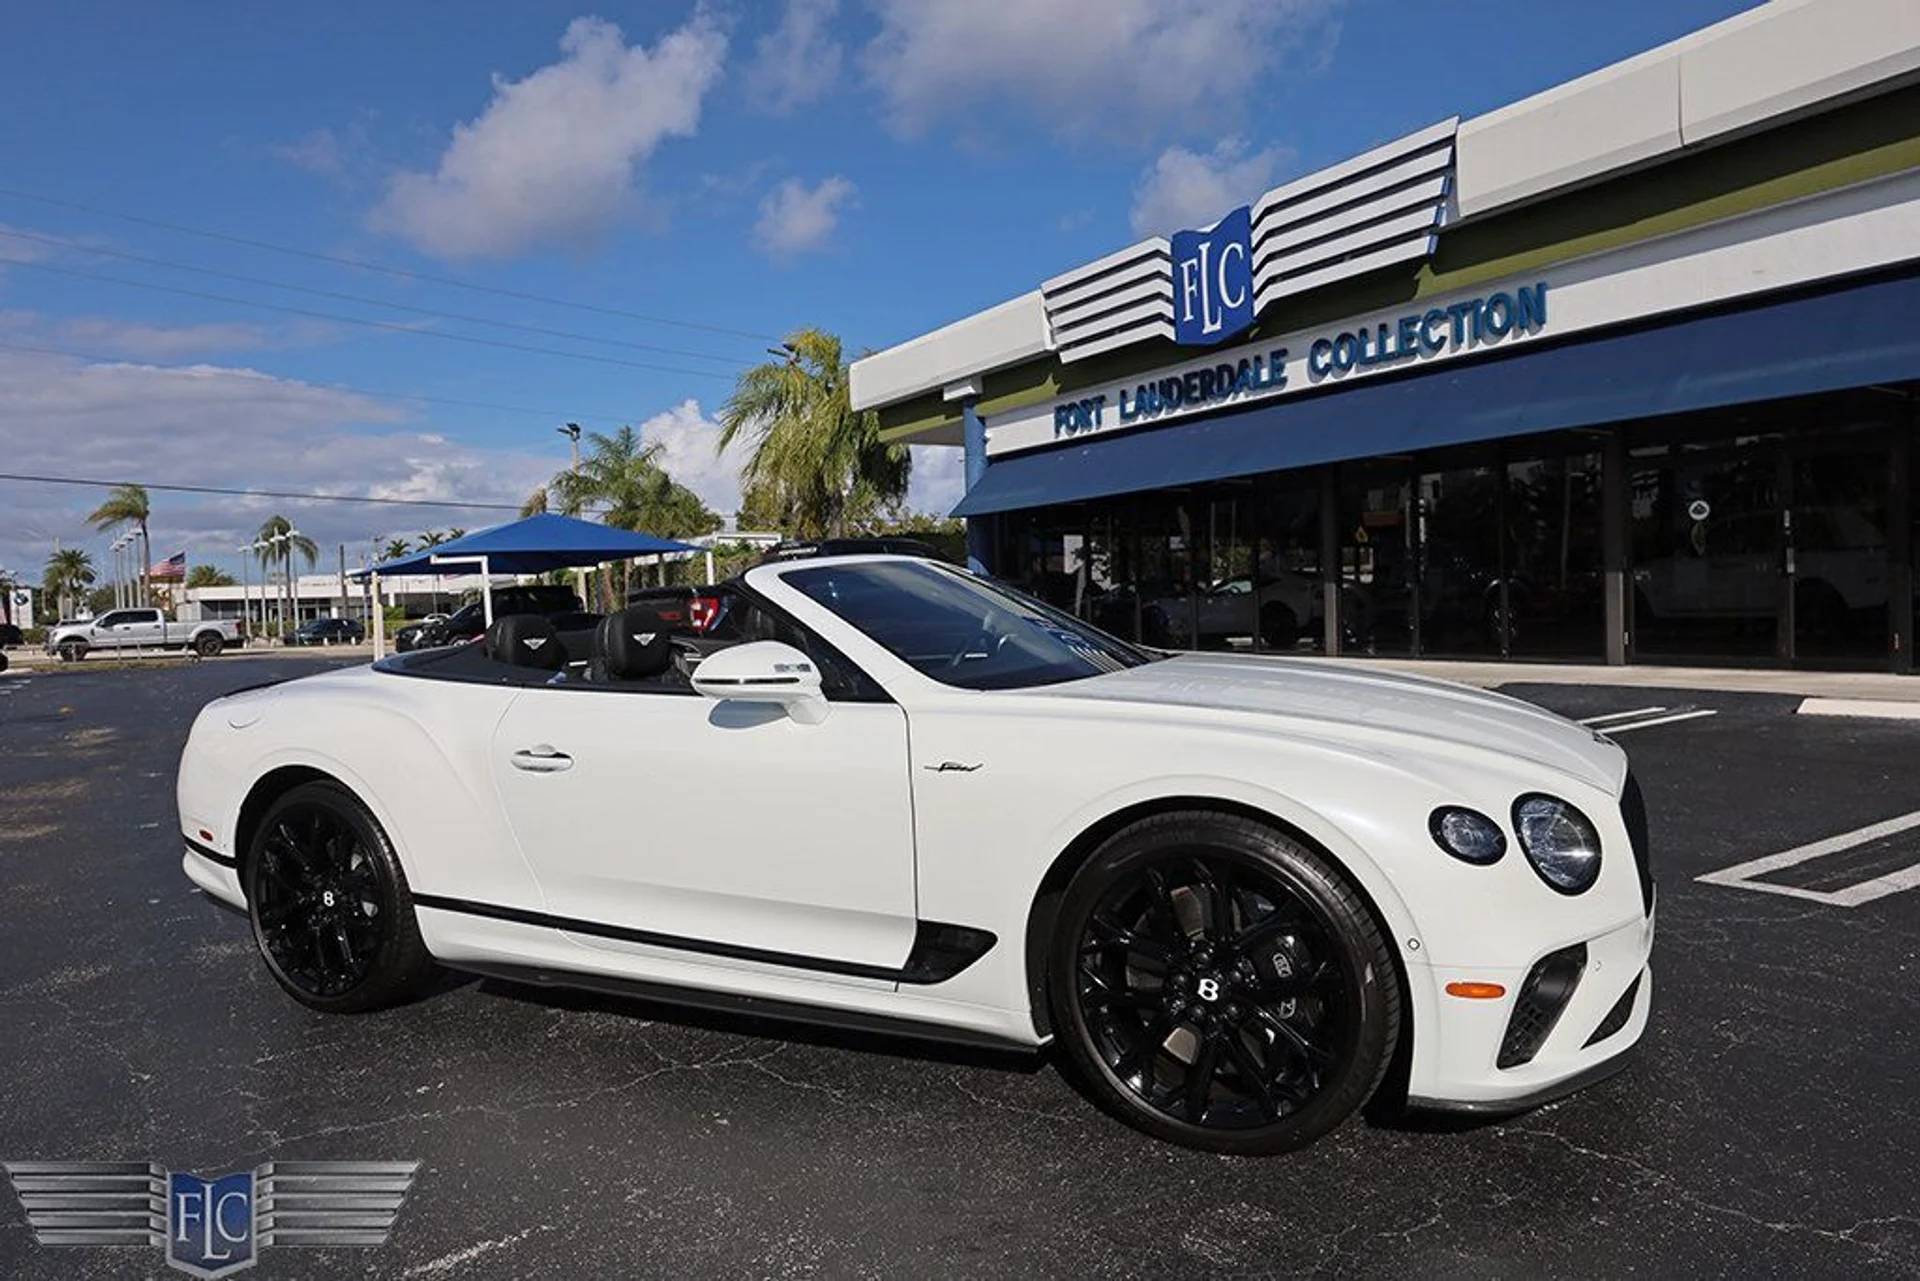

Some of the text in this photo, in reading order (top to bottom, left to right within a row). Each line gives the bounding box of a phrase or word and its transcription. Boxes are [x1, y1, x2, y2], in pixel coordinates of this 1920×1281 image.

[1180, 242, 1245, 334] FLC
[1054, 282, 1548, 438] FORT LAUDERDALE COLLECTION
[1197, 978, 1219, 1002] B
